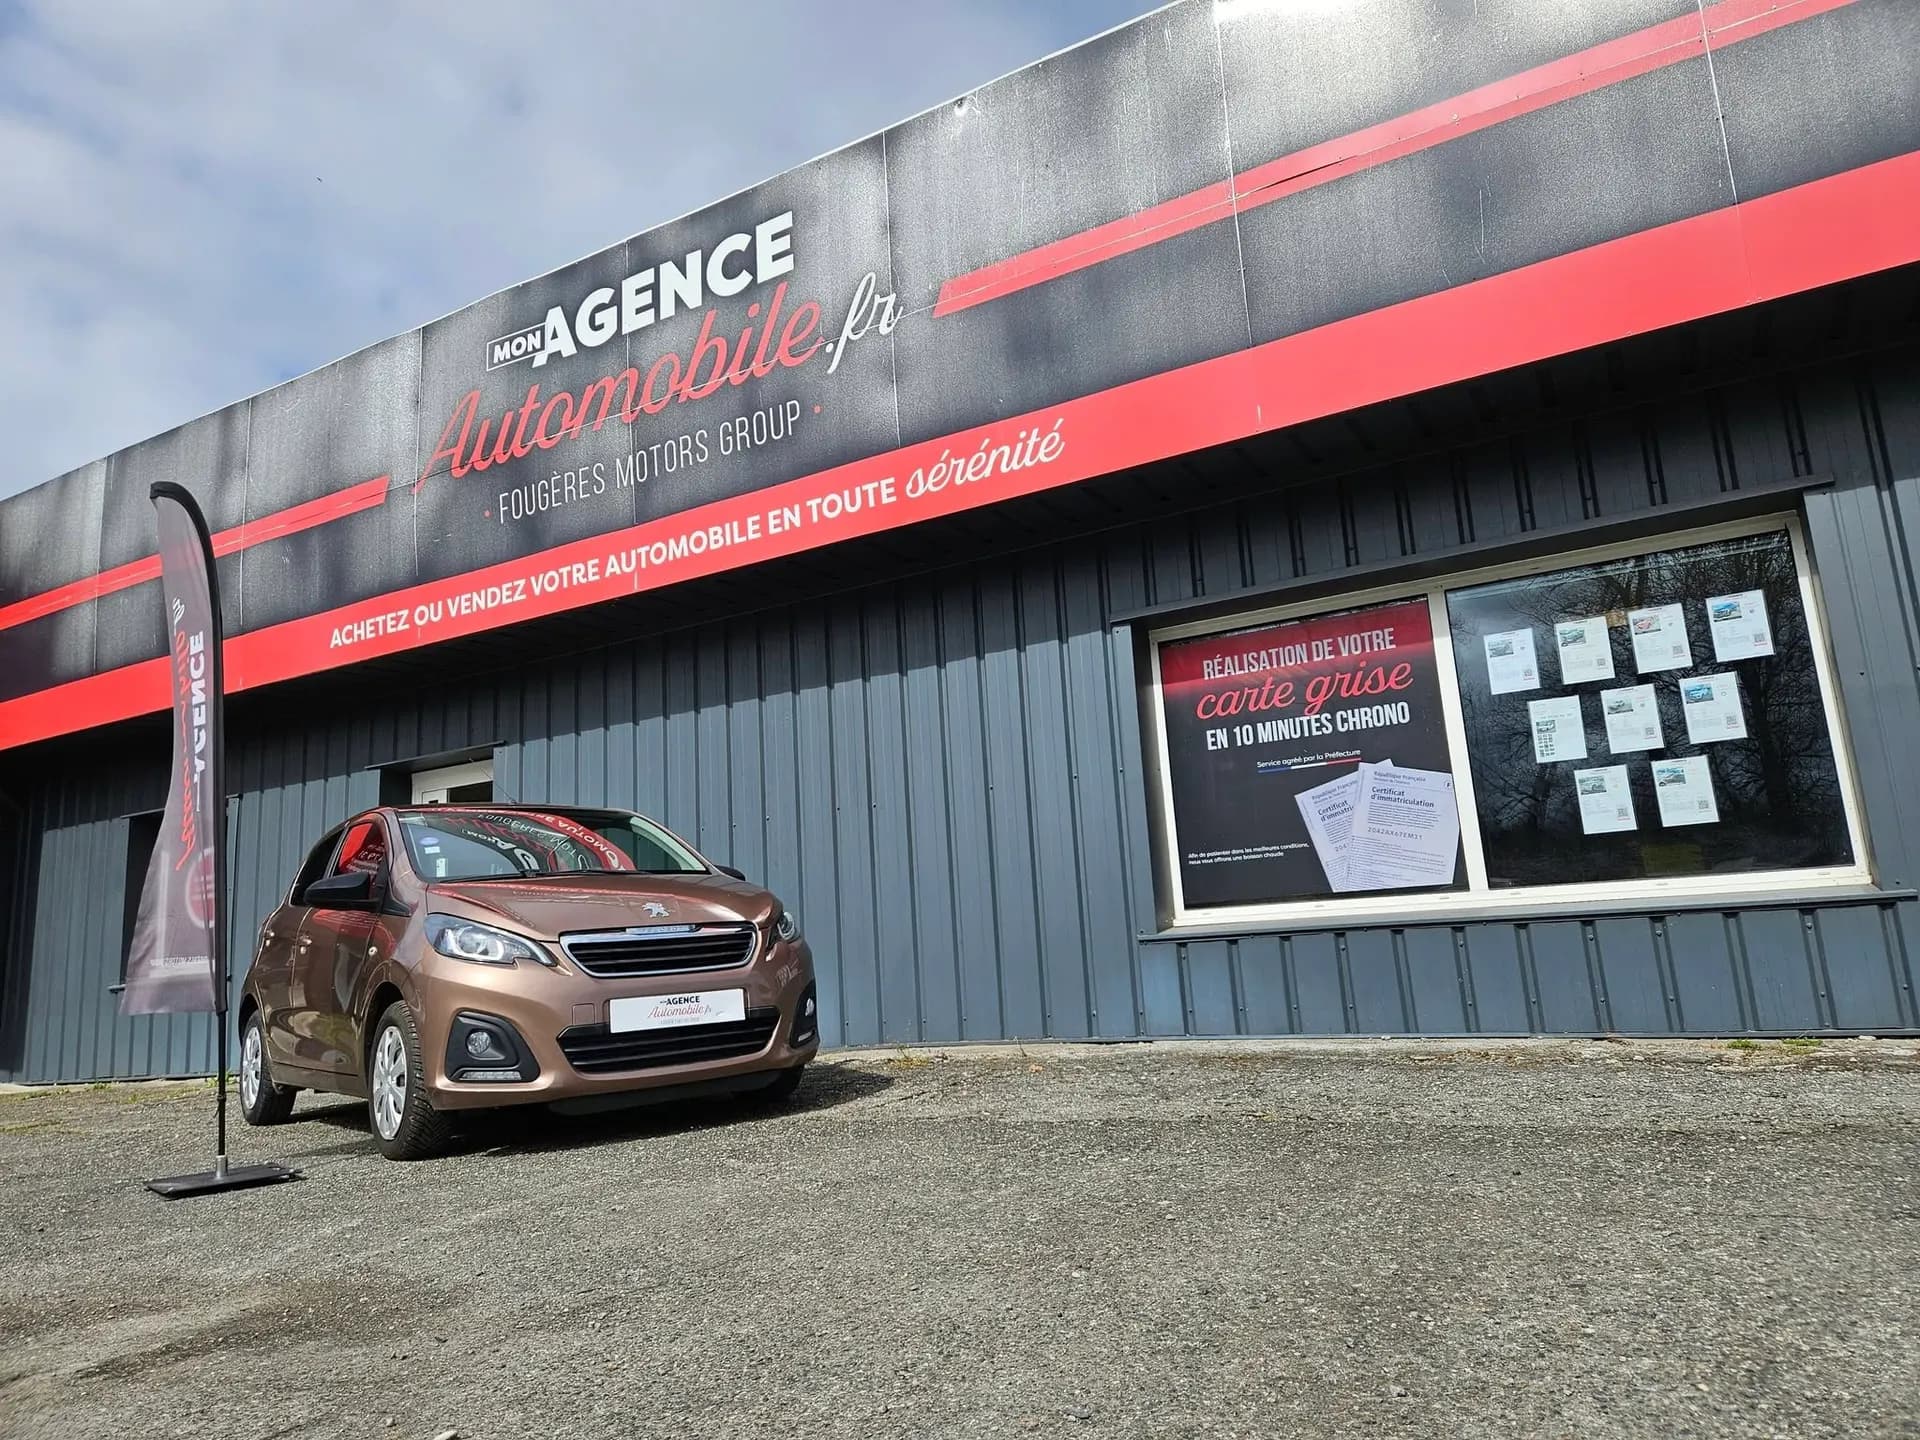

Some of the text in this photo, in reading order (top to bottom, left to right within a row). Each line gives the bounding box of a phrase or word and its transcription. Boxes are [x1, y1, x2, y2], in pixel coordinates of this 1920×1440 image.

[493, 211, 795, 368] MON AGENCE
[499, 400, 801, 524] FOUGÈRES MOTORS GROUP
[330, 419, 1066, 649] ACHETEZ OU VENDEZ VOTRE AUTOMOBILE EN TOUTE sérénité
[1203, 627, 1397, 681] RÉALISATION DE VOTRE
[1197, 661, 1414, 720] carte grise
[1206, 701, 1411, 751] EN 10 MINUTES CHRONO
[1256, 749, 1362, 769] Service agréé par la Préfecture
[1317, 800, 1350, 816] Certificat
[1371, 786, 1406, 797] Certificat
[1371, 793, 1435, 809] d'immatriculation
[666, 996, 701, 1006] AGENCE
